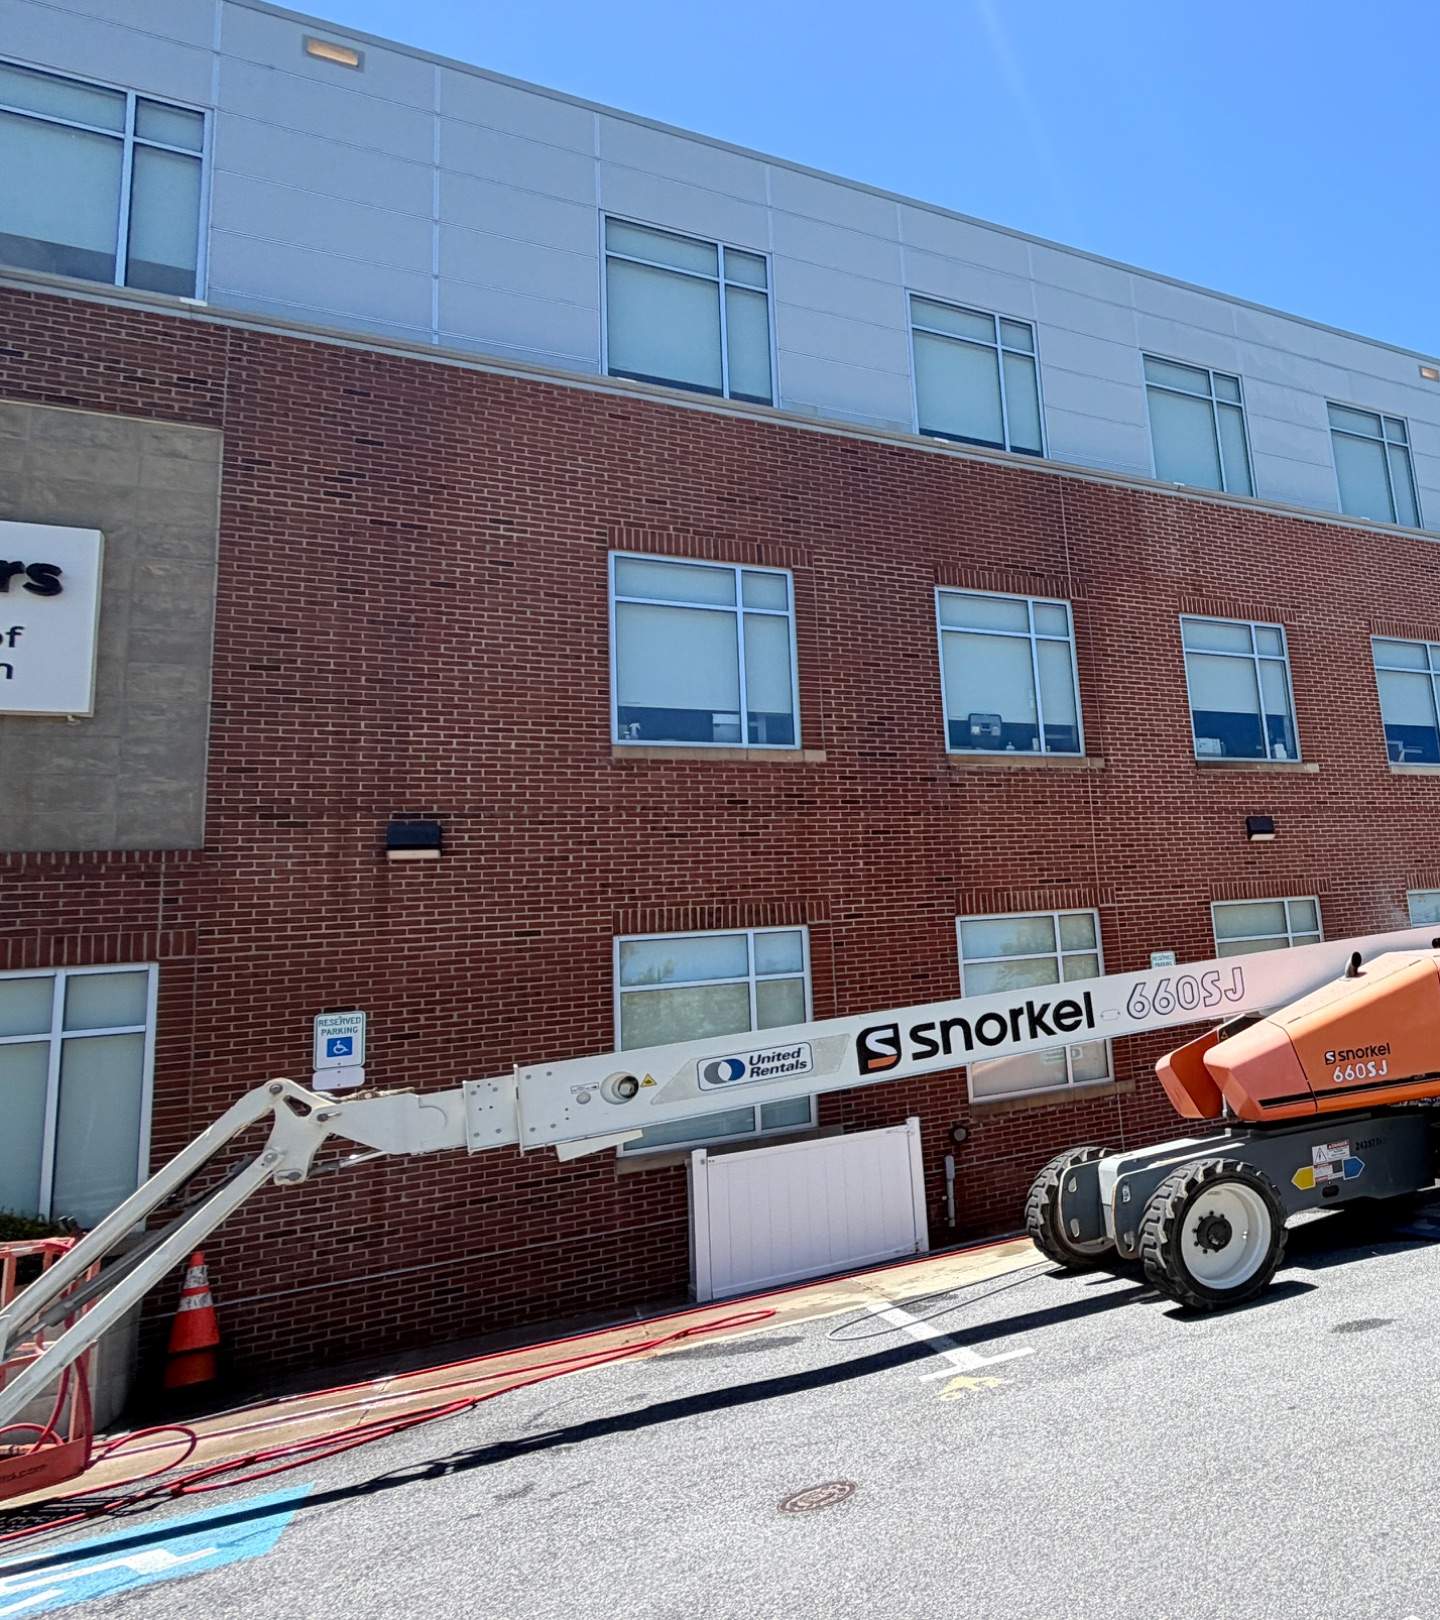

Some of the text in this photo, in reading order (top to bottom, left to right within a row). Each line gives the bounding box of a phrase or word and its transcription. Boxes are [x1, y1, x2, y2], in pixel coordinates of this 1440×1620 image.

[319, 1016, 362, 1027] RESERVED
[909, 991, 1096, 1062] snorkel
[1127, 966, 1245, 1020] 660SJ
[321, 1026, 358, 1036] PARKING
[749, 1047, 801, 1066] United
[1338, 1042, 1391, 1062] snorkel
[749, 1059, 807, 1078] Rentals
[1333, 1060, 1388, 1082] 660SJ
